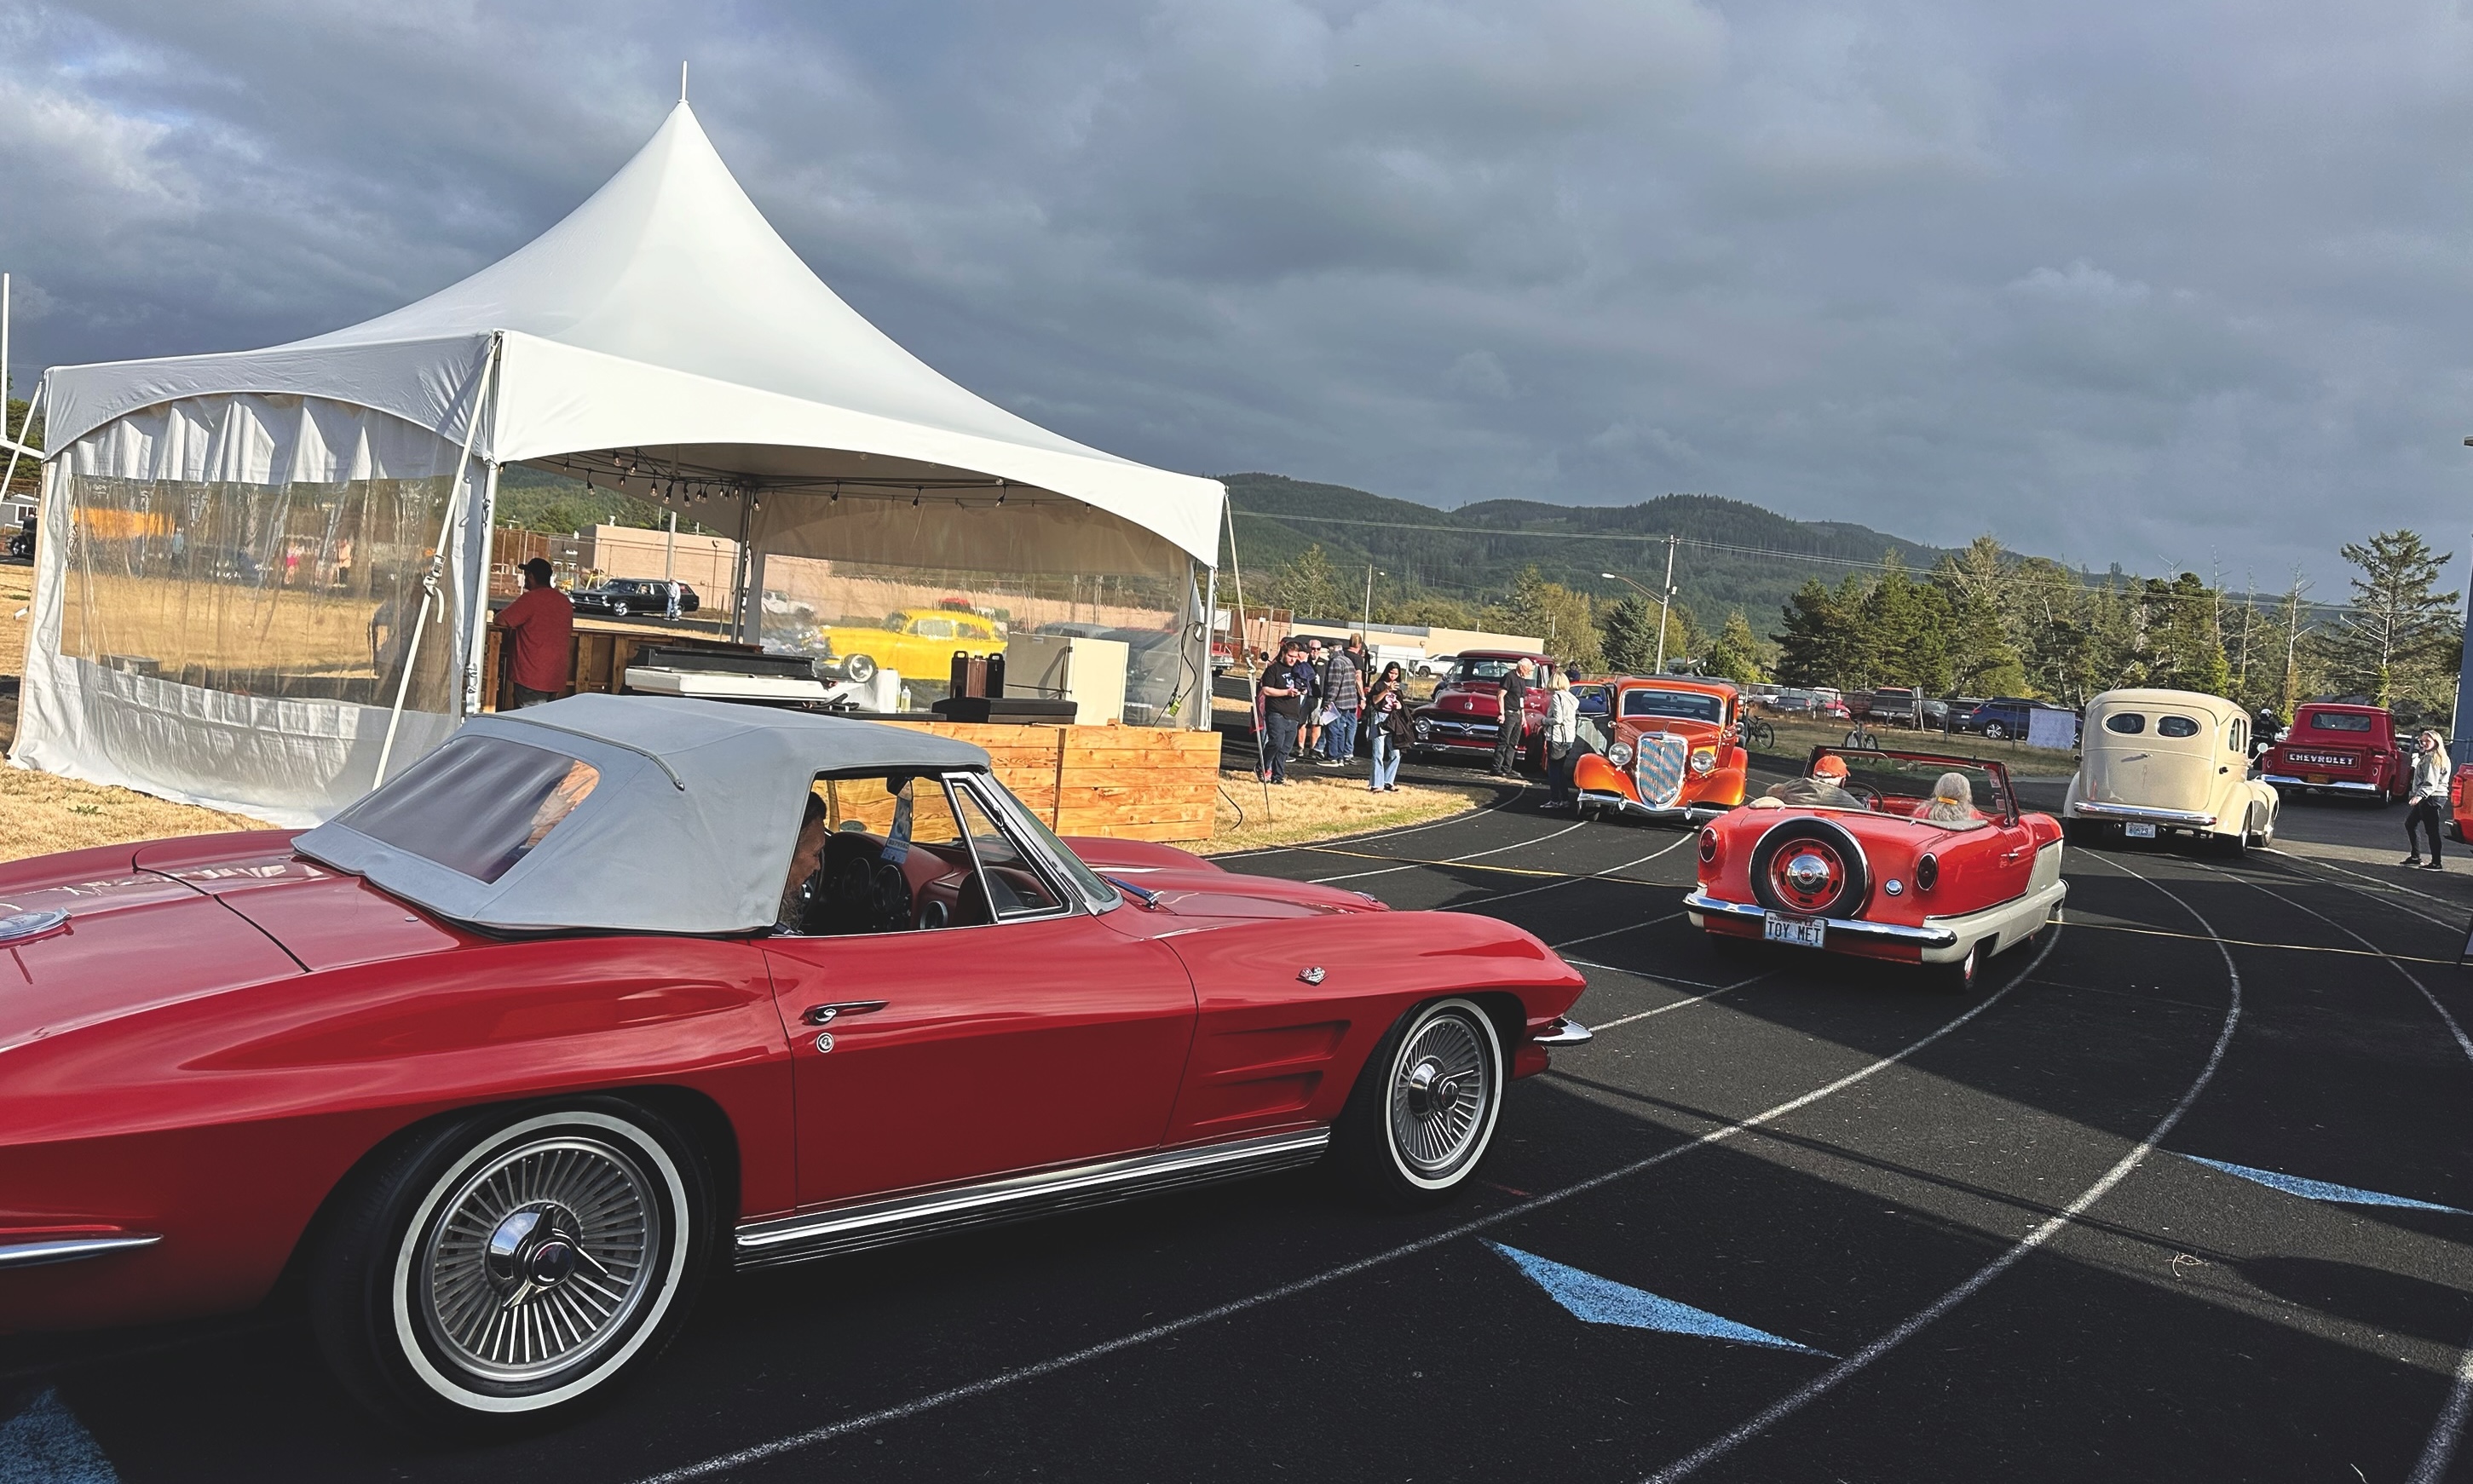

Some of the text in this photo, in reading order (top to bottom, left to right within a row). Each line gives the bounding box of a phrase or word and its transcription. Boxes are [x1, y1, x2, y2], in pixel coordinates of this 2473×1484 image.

[2289, 753, 2354, 765] CHEVROLET
[1768, 921, 1790, 938] TOY
[1797, 926, 1821, 943] MET
